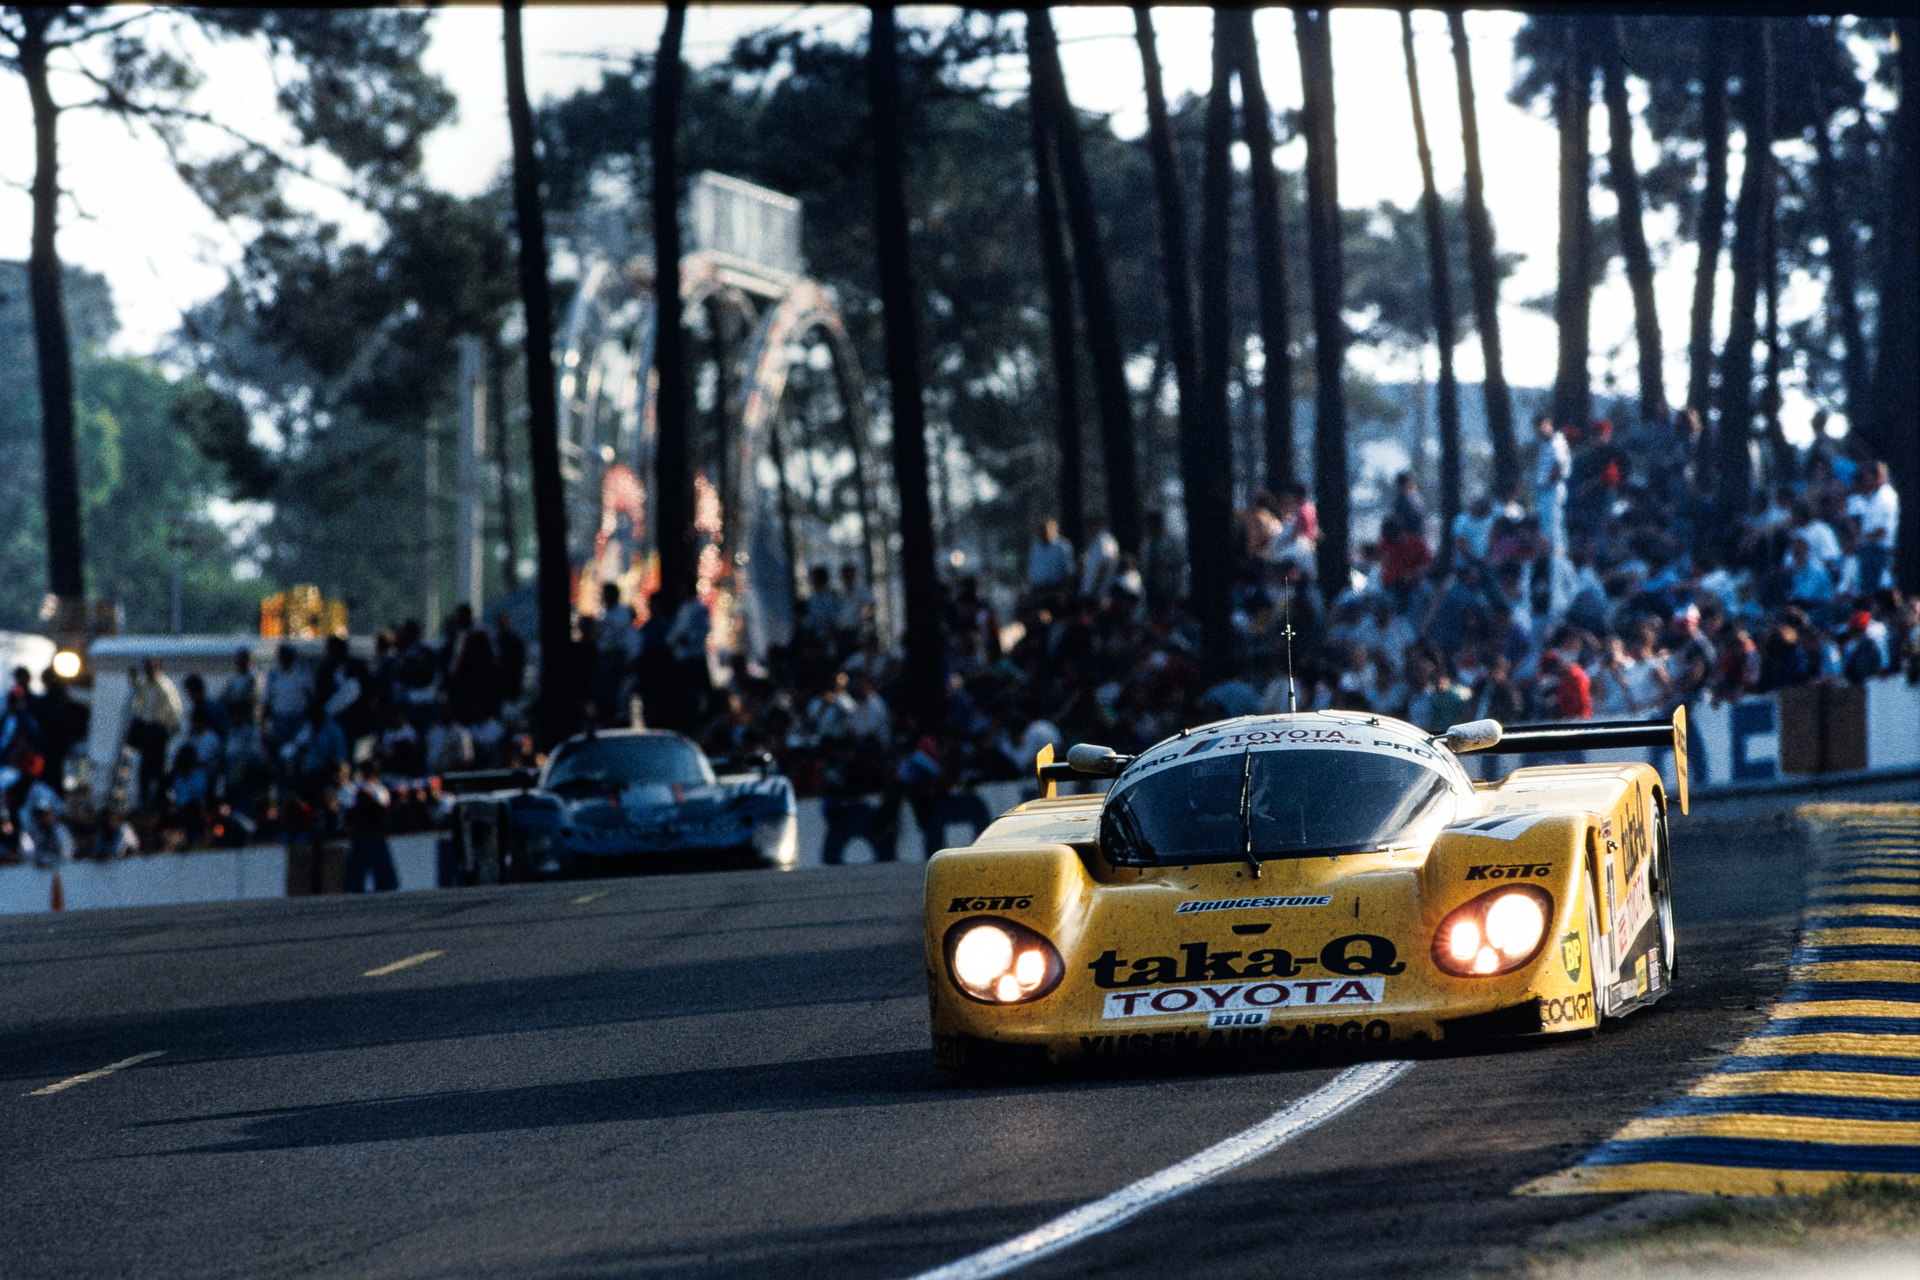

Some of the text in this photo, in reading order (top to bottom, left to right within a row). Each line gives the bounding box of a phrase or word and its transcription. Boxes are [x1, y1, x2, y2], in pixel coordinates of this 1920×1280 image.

[1215, 740, 1282, 750] TEAM
[1229, 729, 1346, 743] TOYOTA
[1373, 740, 1433, 760] PRO
[1123, 753, 1179, 780] PRO
[1176, 895, 1332, 913] BRIDGESTONE
[1087, 933, 1407, 989] taka-Q
[1563, 938, 1581, 972] BP
[1112, 980, 1375, 1016] TOYOTA
